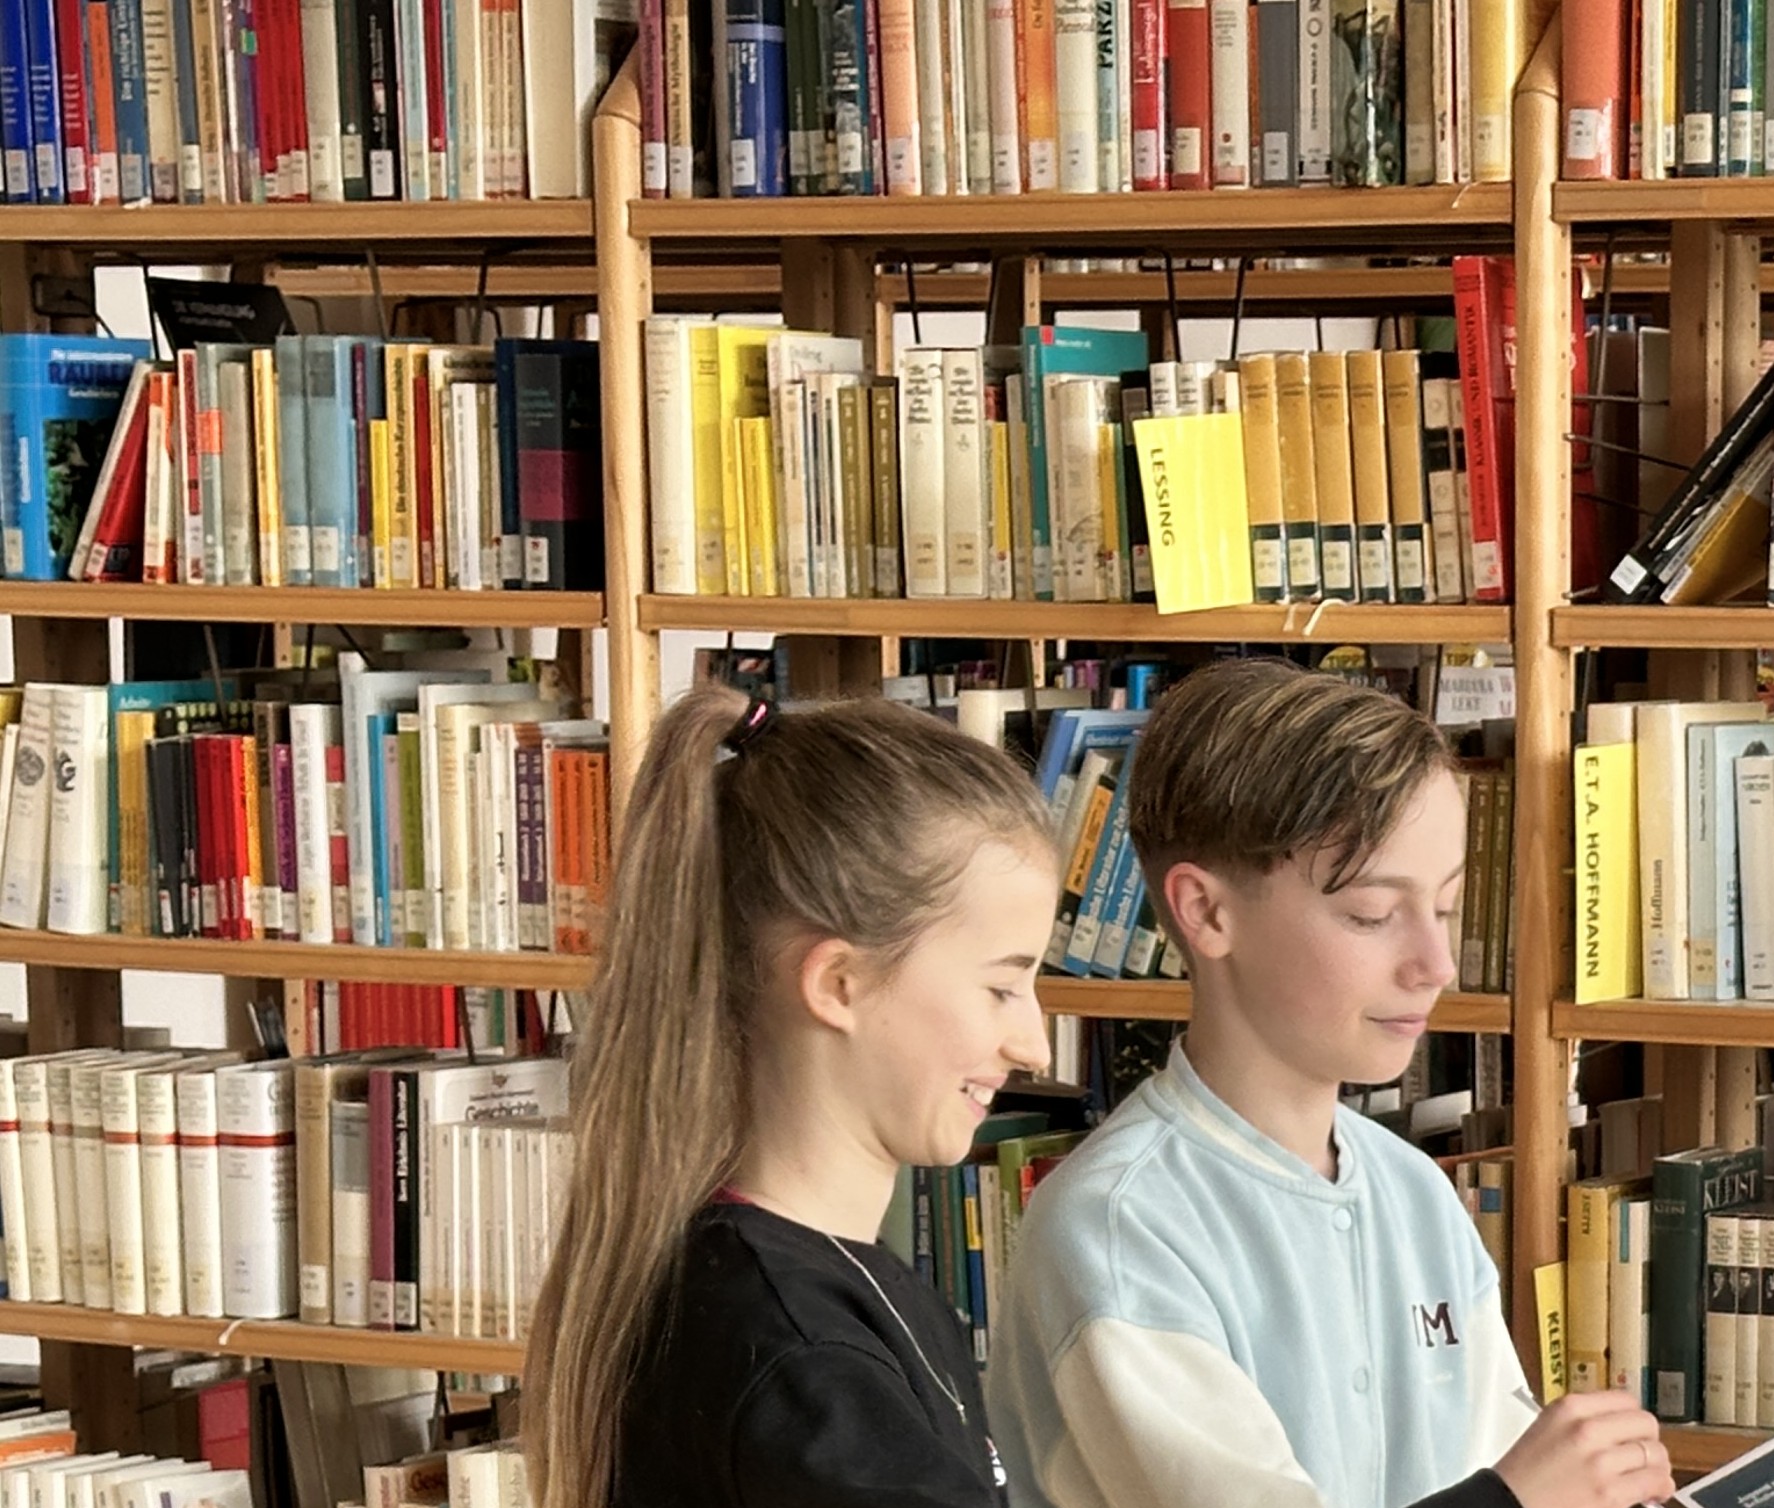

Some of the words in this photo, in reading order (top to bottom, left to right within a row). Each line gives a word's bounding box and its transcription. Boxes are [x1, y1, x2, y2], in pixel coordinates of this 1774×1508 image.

[1463, 304, 1479, 379] ROMANTIK
[1150, 448, 1175, 546] LESSING
[1584, 755, 1601, 826] E.T.A.
[1585, 832, 1601, 979] HOFFMANN
[1650, 859, 1664, 932] Hoffmann
[1704, 1170, 1758, 1209] KLEIST
[1547, 1311, 1564, 1386] KLEIST
